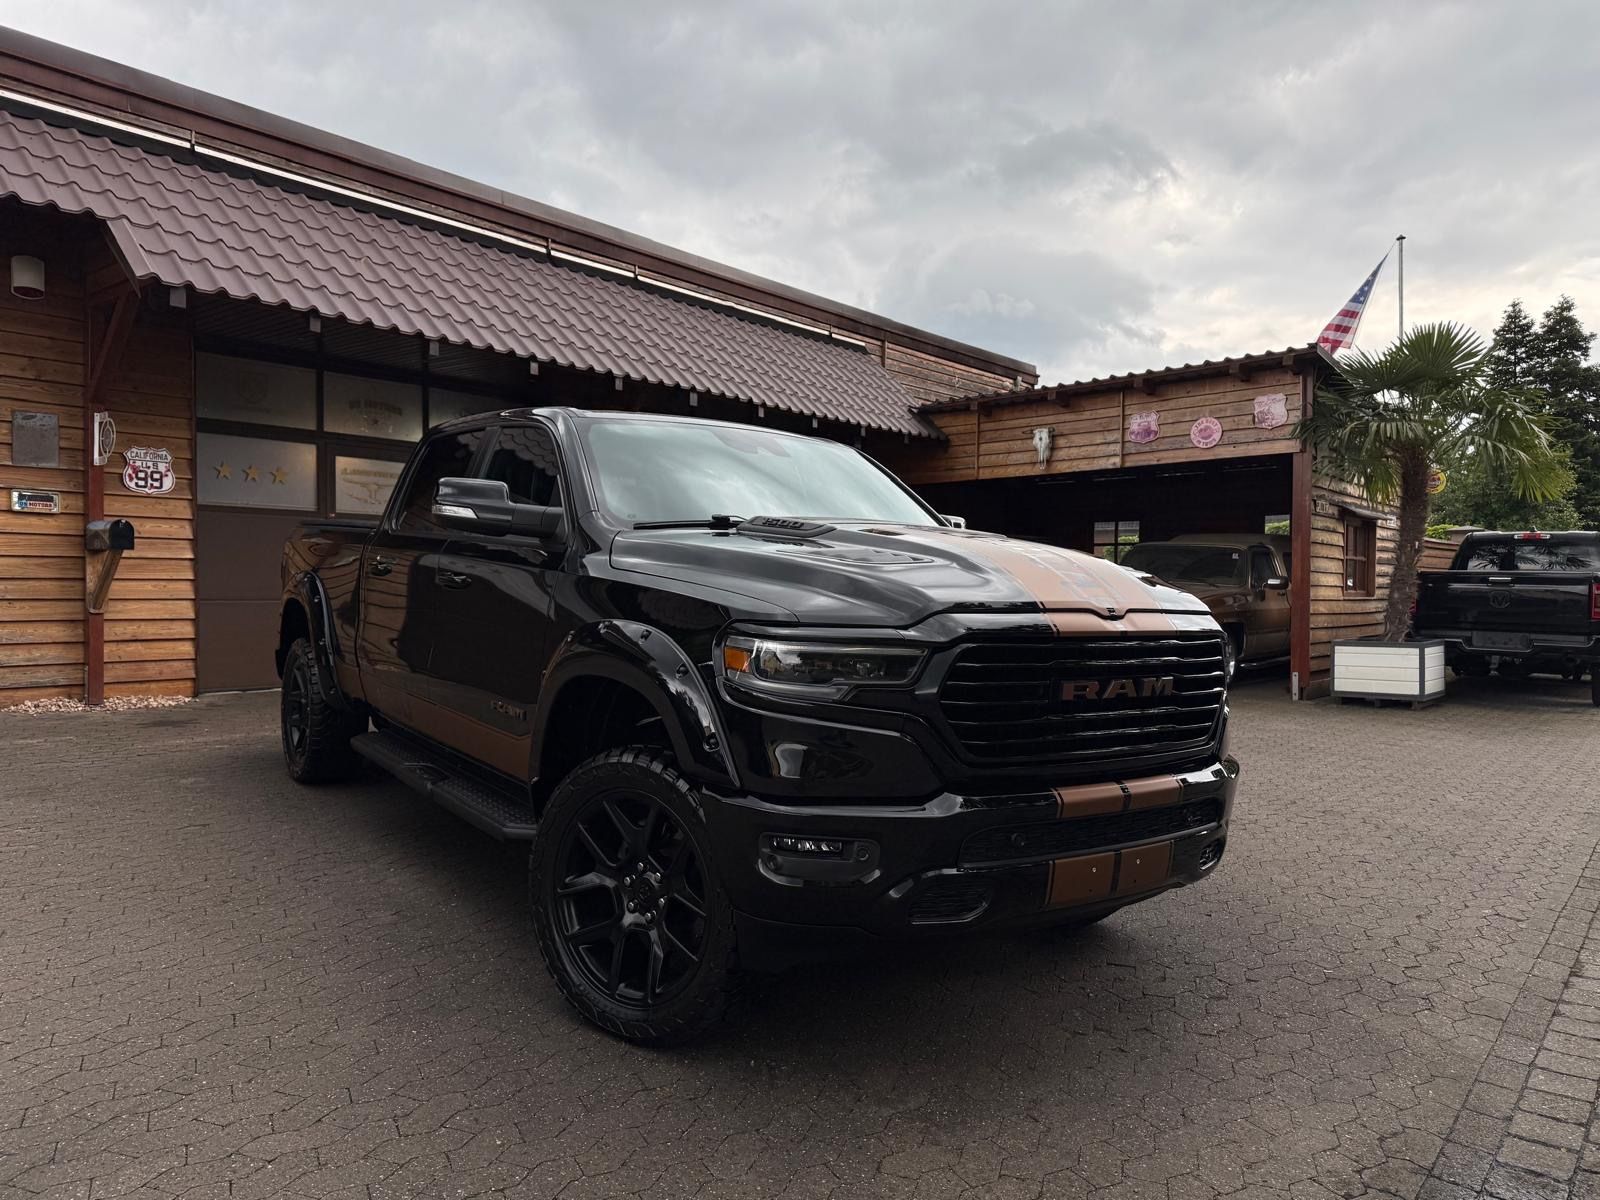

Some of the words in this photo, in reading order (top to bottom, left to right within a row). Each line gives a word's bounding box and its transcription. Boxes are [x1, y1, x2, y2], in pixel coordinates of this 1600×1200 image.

[130, 450, 169, 460] CALIFORNIA
[135, 470, 163, 489] 99
[761, 517, 804, 529] 1500
[1062, 676, 1174, 700] RAM
